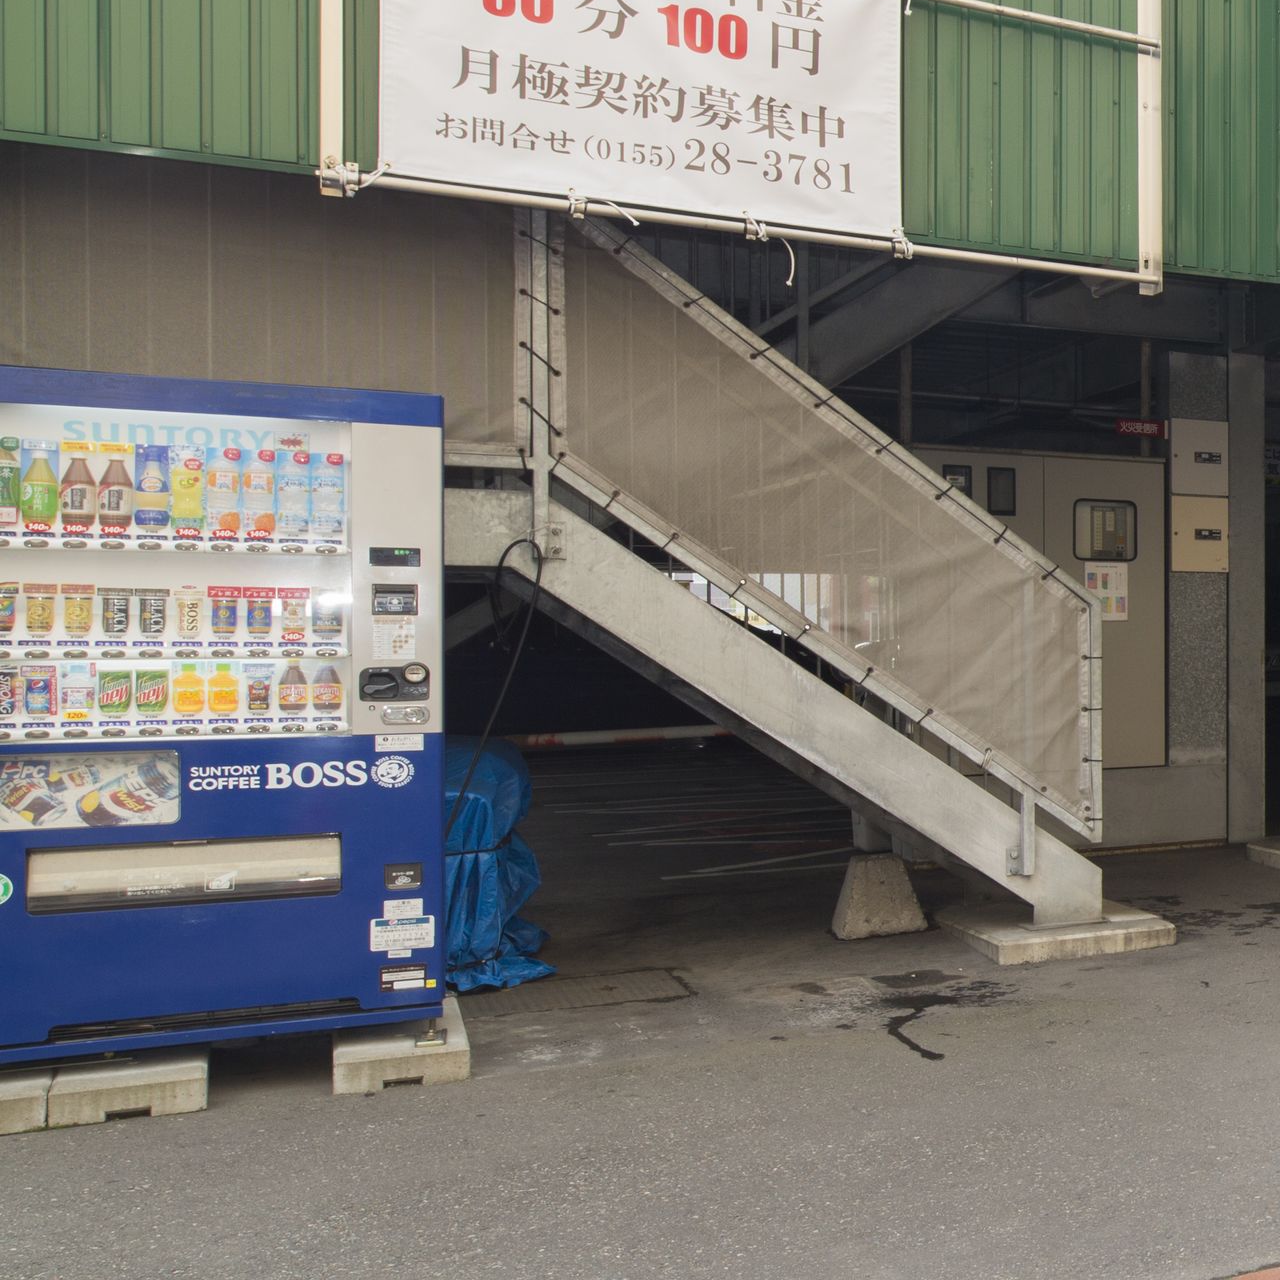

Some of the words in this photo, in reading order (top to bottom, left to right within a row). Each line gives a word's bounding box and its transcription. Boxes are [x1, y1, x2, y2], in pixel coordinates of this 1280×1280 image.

[452, 45, 846, 149] 月極契約募集中
[113, 599, 126, 632] BLACK
[151, 599, 163, 632] BLACK
[186, 601, 199, 632] BOSS
[188, 776, 261, 791] COFFEE
[190, 764, 261, 778] SUNTORY
[265, 760, 368, 790] BOSS
